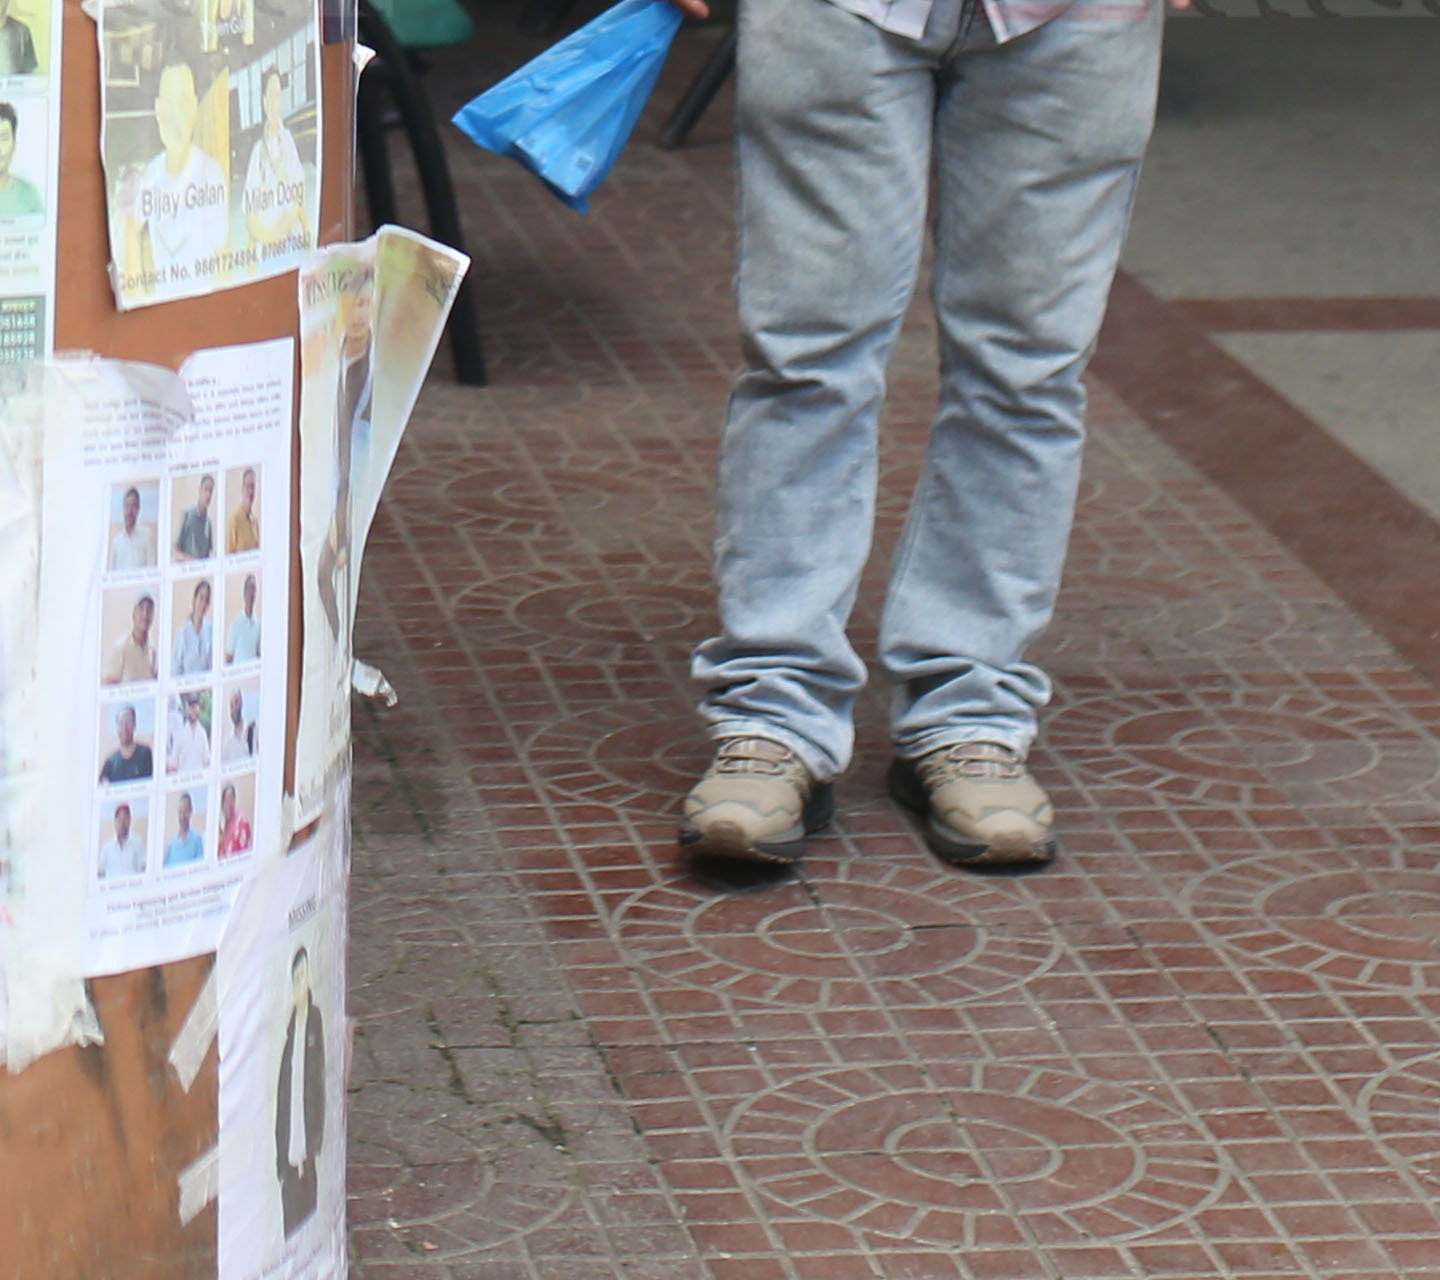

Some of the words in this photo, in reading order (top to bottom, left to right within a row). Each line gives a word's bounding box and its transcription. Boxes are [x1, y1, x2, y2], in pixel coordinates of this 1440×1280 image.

[142, 190, 180, 219] Bijay
[185, 182, 225, 209] Galan
[245, 191, 274, 214] Milan
